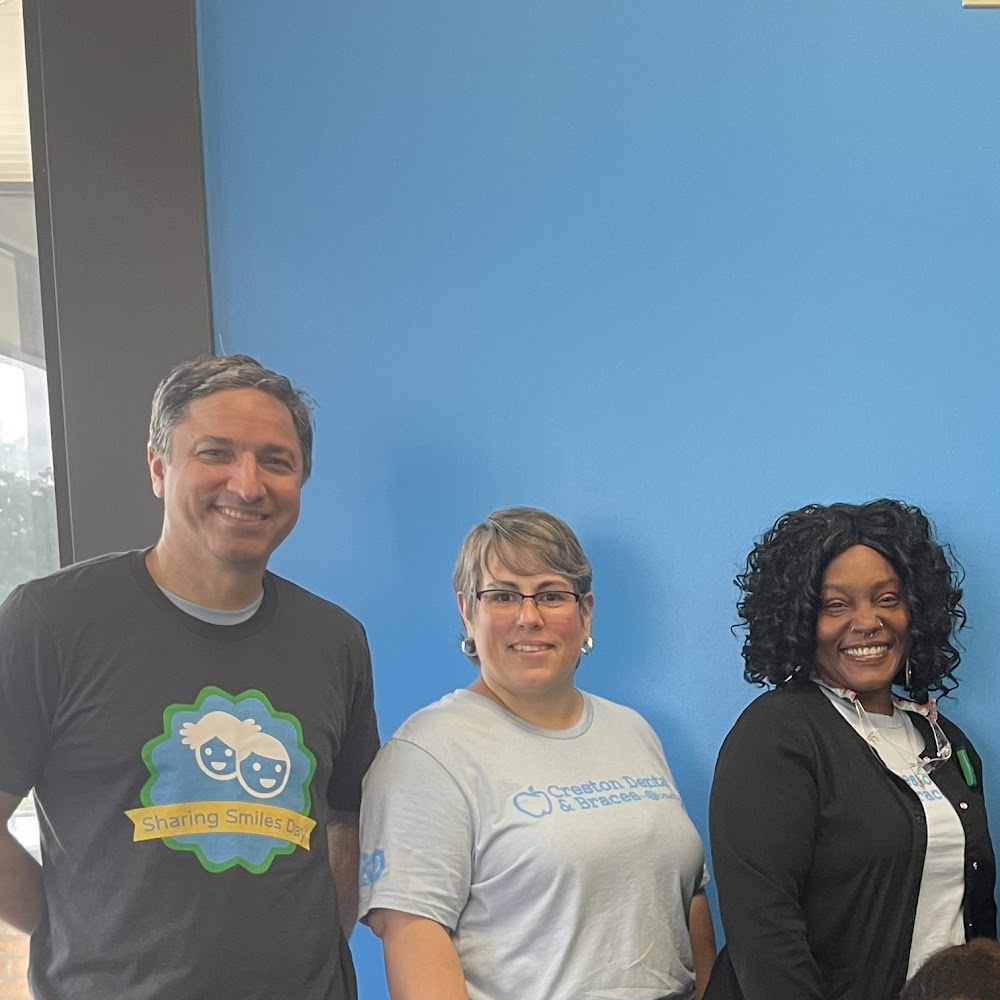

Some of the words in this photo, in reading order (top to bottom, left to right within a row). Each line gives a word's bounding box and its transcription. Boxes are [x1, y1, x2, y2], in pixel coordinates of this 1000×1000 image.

[547, 779, 622, 798] Creston
[559, 798, 577, 813] &
[578, 789, 642, 810] Braces
[142, 809, 219, 832] Sharing
[226, 808, 282, 830] Smiles
[286, 818, 309, 843] Day
